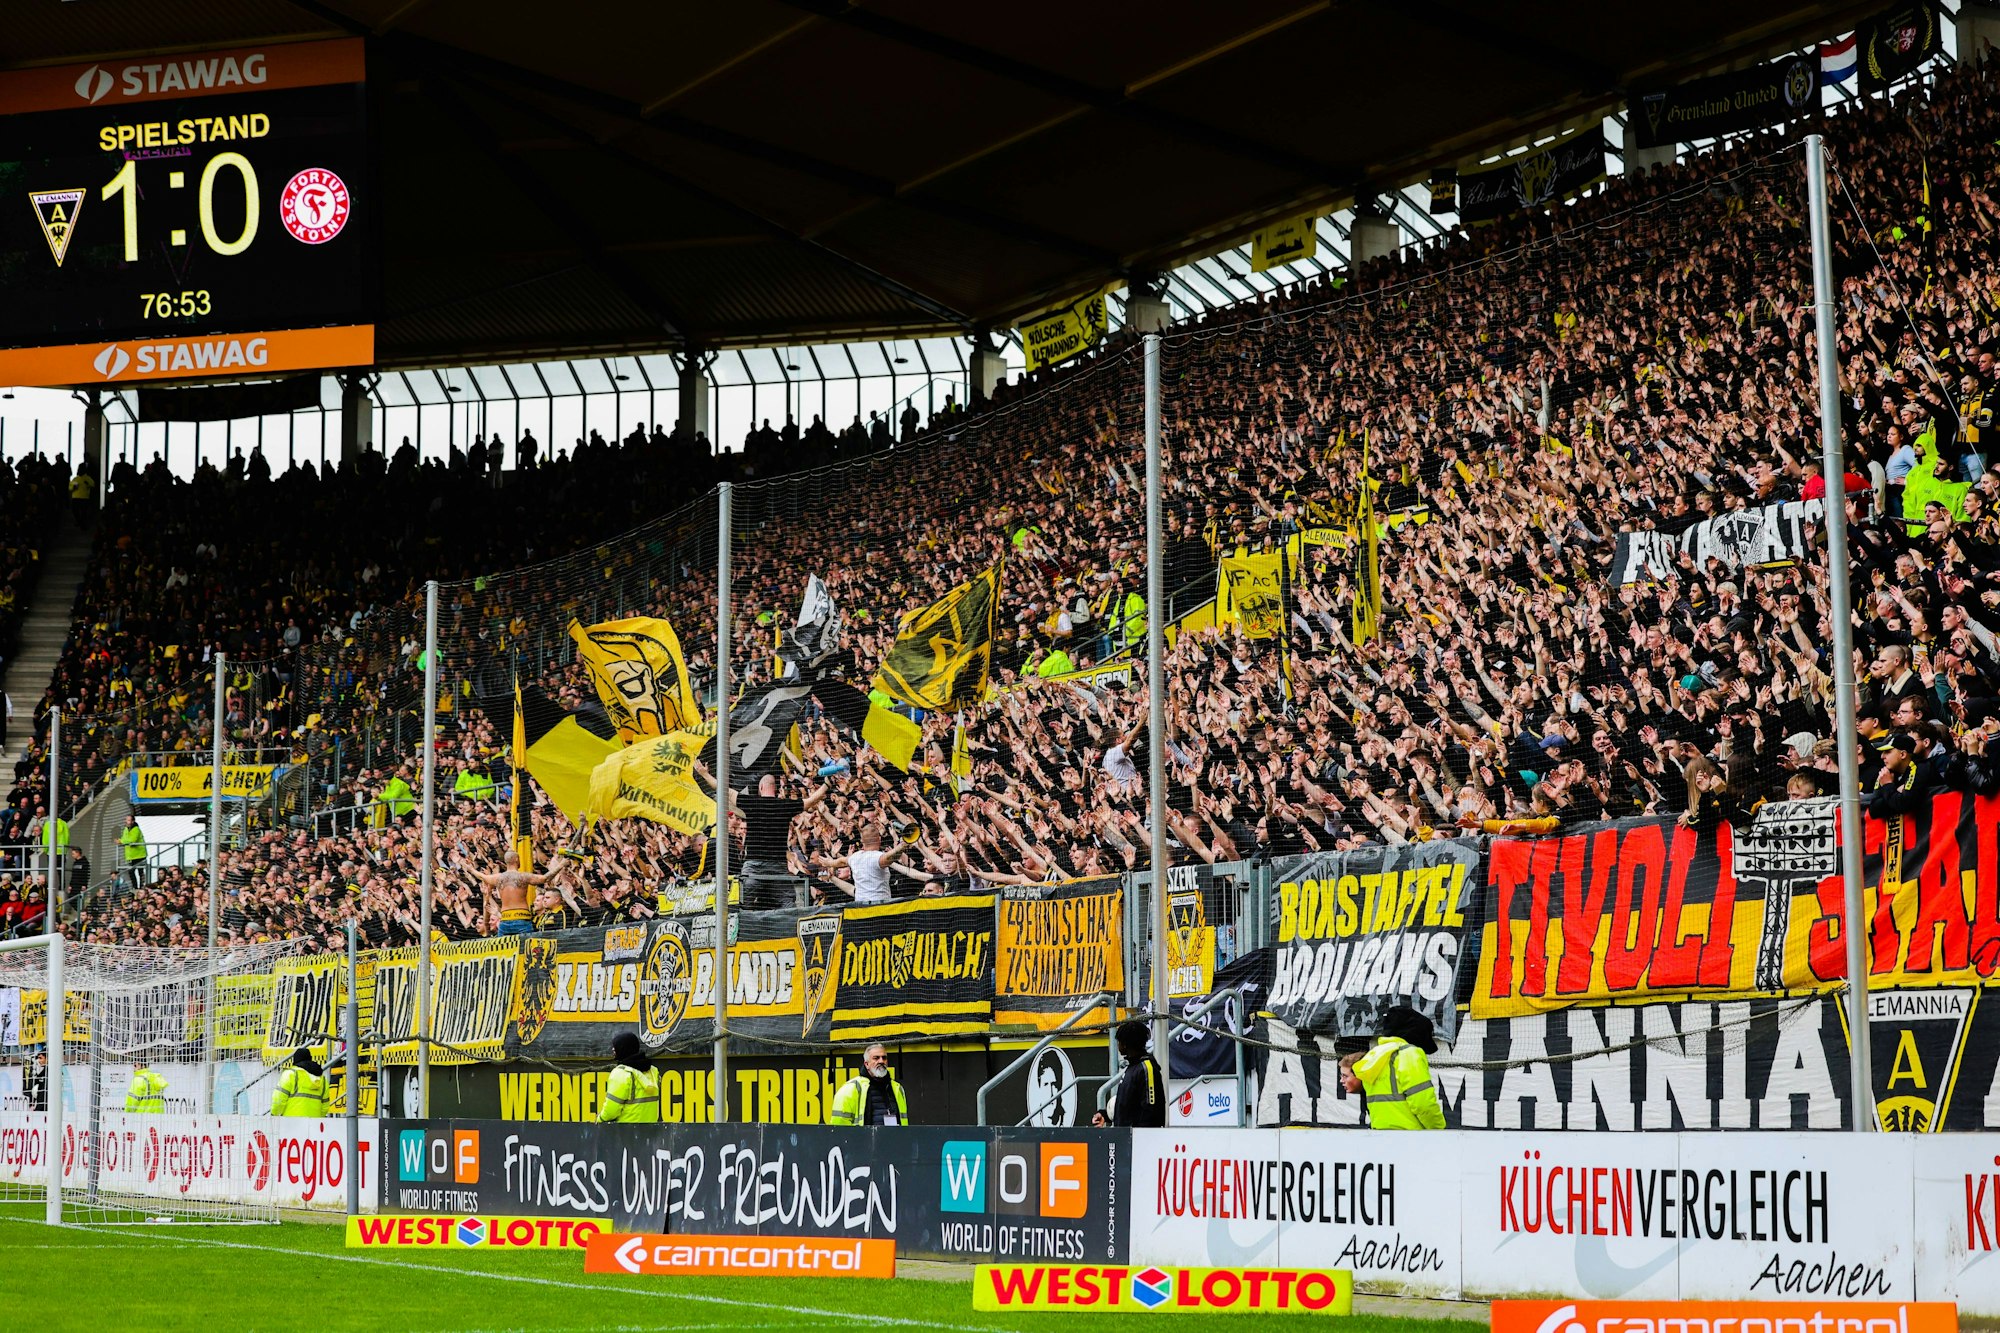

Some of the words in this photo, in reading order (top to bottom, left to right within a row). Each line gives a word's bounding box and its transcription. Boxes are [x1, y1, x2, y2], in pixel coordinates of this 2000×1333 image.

[121, 54, 267, 96] STAWAG
[1667, 97, 1731, 122] Grenzland
[1735, 84, 1778, 110] United
[99, 113, 270, 151] SPIELSTAND
[37, 193, 79, 203] ALEMANNIA
[101, 151, 260, 262] 1:0
[290, 172, 348, 216] FORTUNA
[297, 219, 340, 241] KÖLN
[140, 290, 212, 319] 76:53
[1028, 320, 1066, 346] KÖLSCHE
[136, 338, 268, 372] STAWAG
[144, 772, 182, 791] 100%
[203, 771, 266, 790] ACHEN
[1167, 865, 1200, 892] SZENE
[1279, 864, 1466, 942] BOXSTAFFEL
[1489, 819, 1738, 998] TIVOLI
[800, 920, 838, 933] ALEMANNIA
[811, 936, 823, 964] A
[842, 939, 892, 987] DOM
[1266, 932, 1458, 1006] HOOLIGANS
[553, 962, 638, 1012] KARLS
[1168, 964, 1203, 994] ACHEN
[1866, 995, 1963, 1019] LEMANNIA
[1256, 998, 1842, 1131] ALMANNIA
[1887, 1030, 1928, 1091] A
[1208, 1093, 1230, 1108] beko
[164, 1120, 214, 1193] regio
[278, 1122, 344, 1201] regio
[400, 1188, 430, 1210] WORLD
[431, 1189, 443, 1211] OF
[444, 1190, 479, 1213] FITNESS
[504, 1134, 609, 1213] FITNESS
[622, 1145, 706, 1221] UNTER
[717, 1142, 897, 1234] FREUNDEN
[1156, 1144, 1396, 1226] KÜCHENVERGLEICH
[1499, 1150, 1830, 1243] KÜCHENVERGLEICH
[357, 1217, 455, 1246] WEST
[489, 1219, 600, 1247] LOTTO
[941, 1222, 993, 1253] WORLD
[999, 1225, 1019, 1255] OF
[1022, 1227, 1085, 1260] FITNESS
[1334, 1231, 1445, 1272] Aachen
[654, 1241, 862, 1272] camcontrol
[1750, 1250, 1892, 1299] Aachen
[989, 1267, 1129, 1306] WEST
[1176, 1271, 1337, 1310] LOTTO
